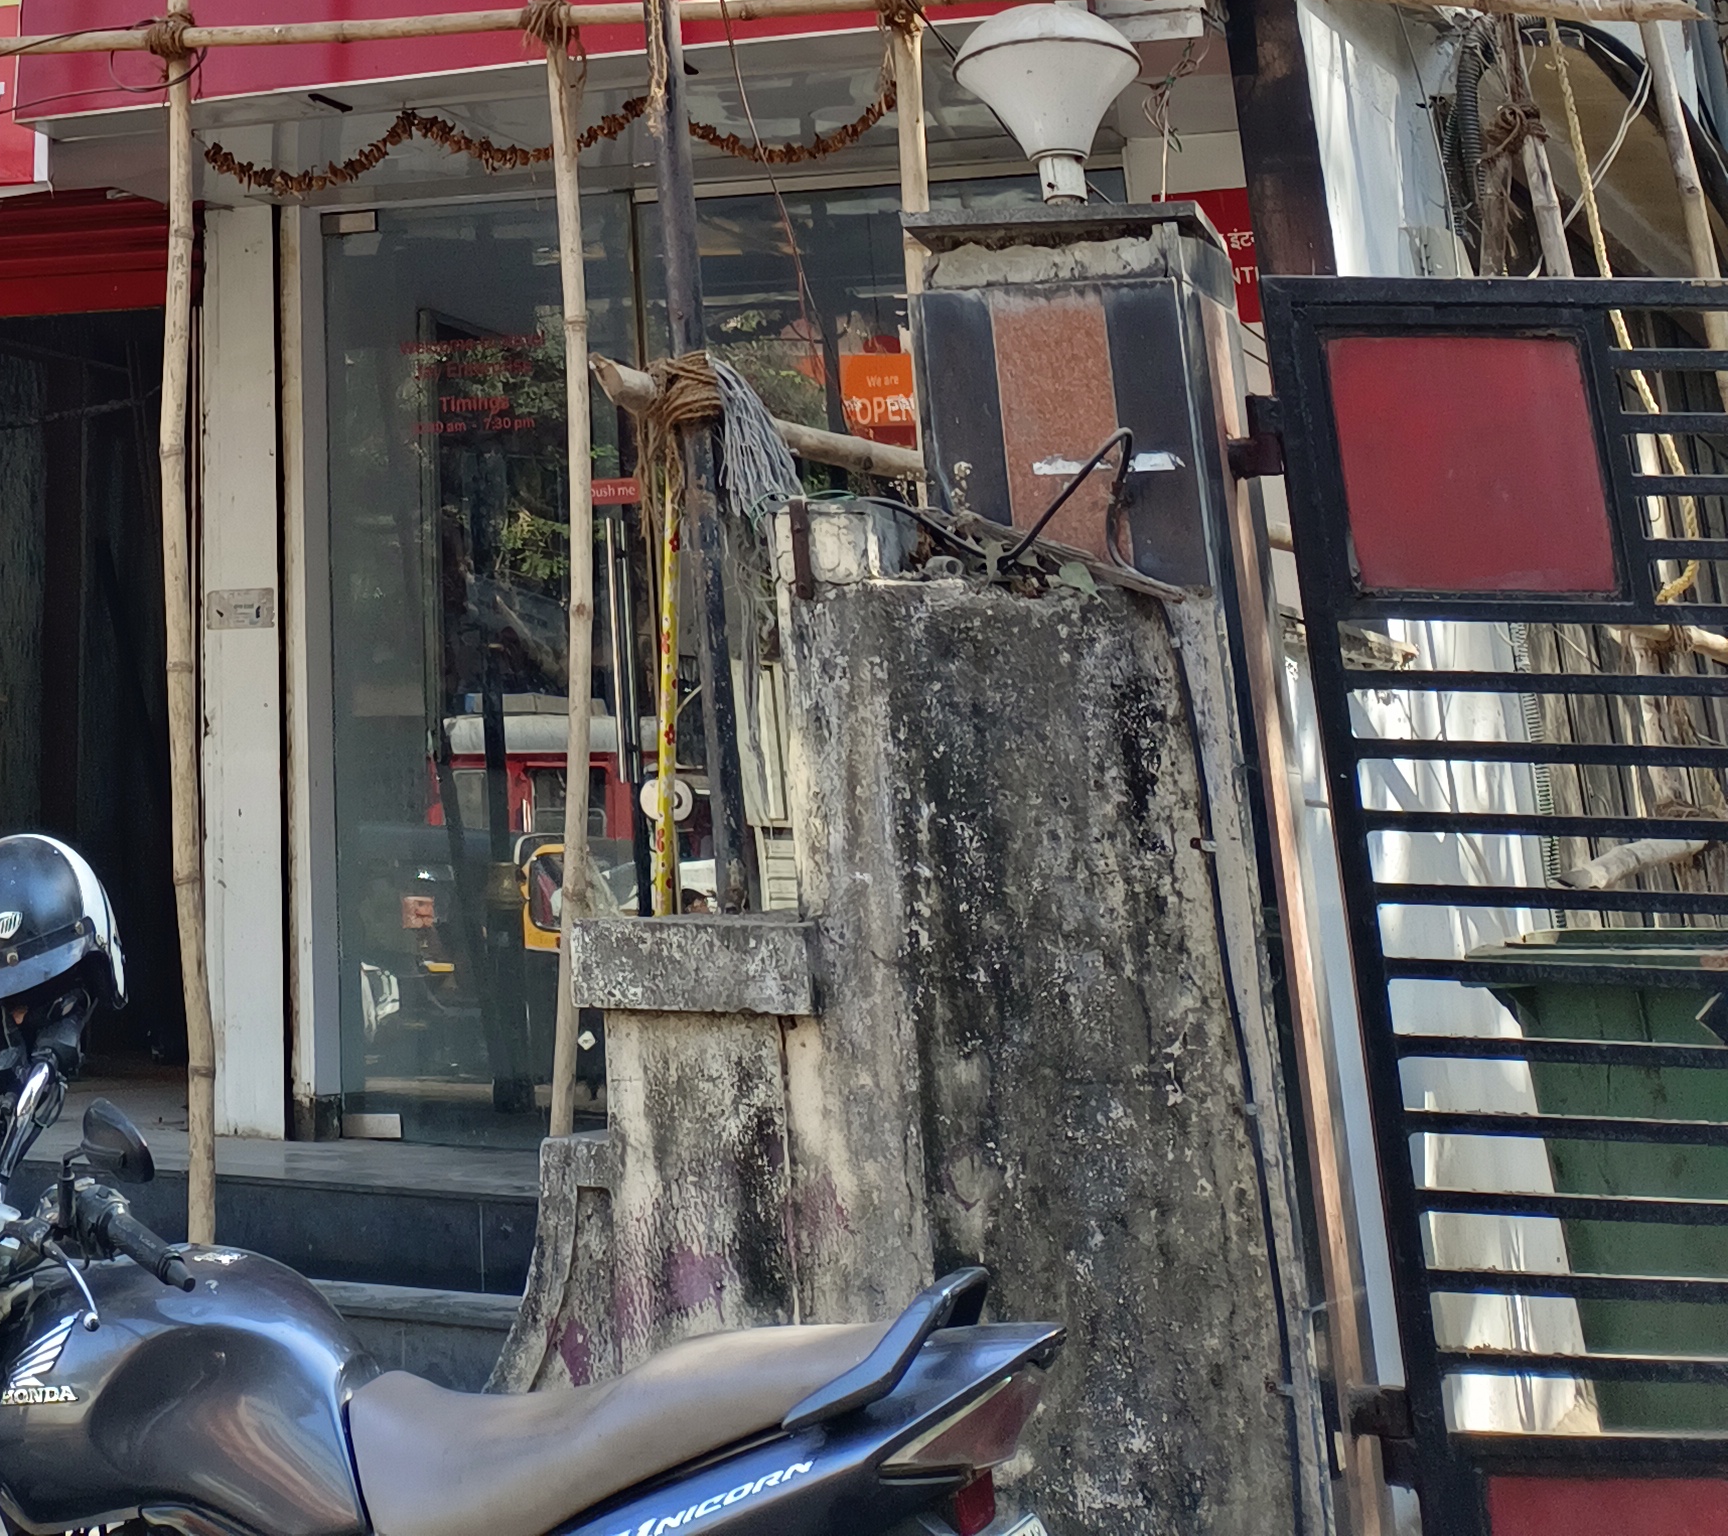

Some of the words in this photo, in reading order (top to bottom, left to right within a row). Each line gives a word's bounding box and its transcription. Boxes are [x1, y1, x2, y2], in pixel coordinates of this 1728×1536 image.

[439, 396, 510, 415] Timings
[514, 418, 535, 431] pm
[617, 486, 635, 497] me
[1, 1385, 78, 1405] HONDA
